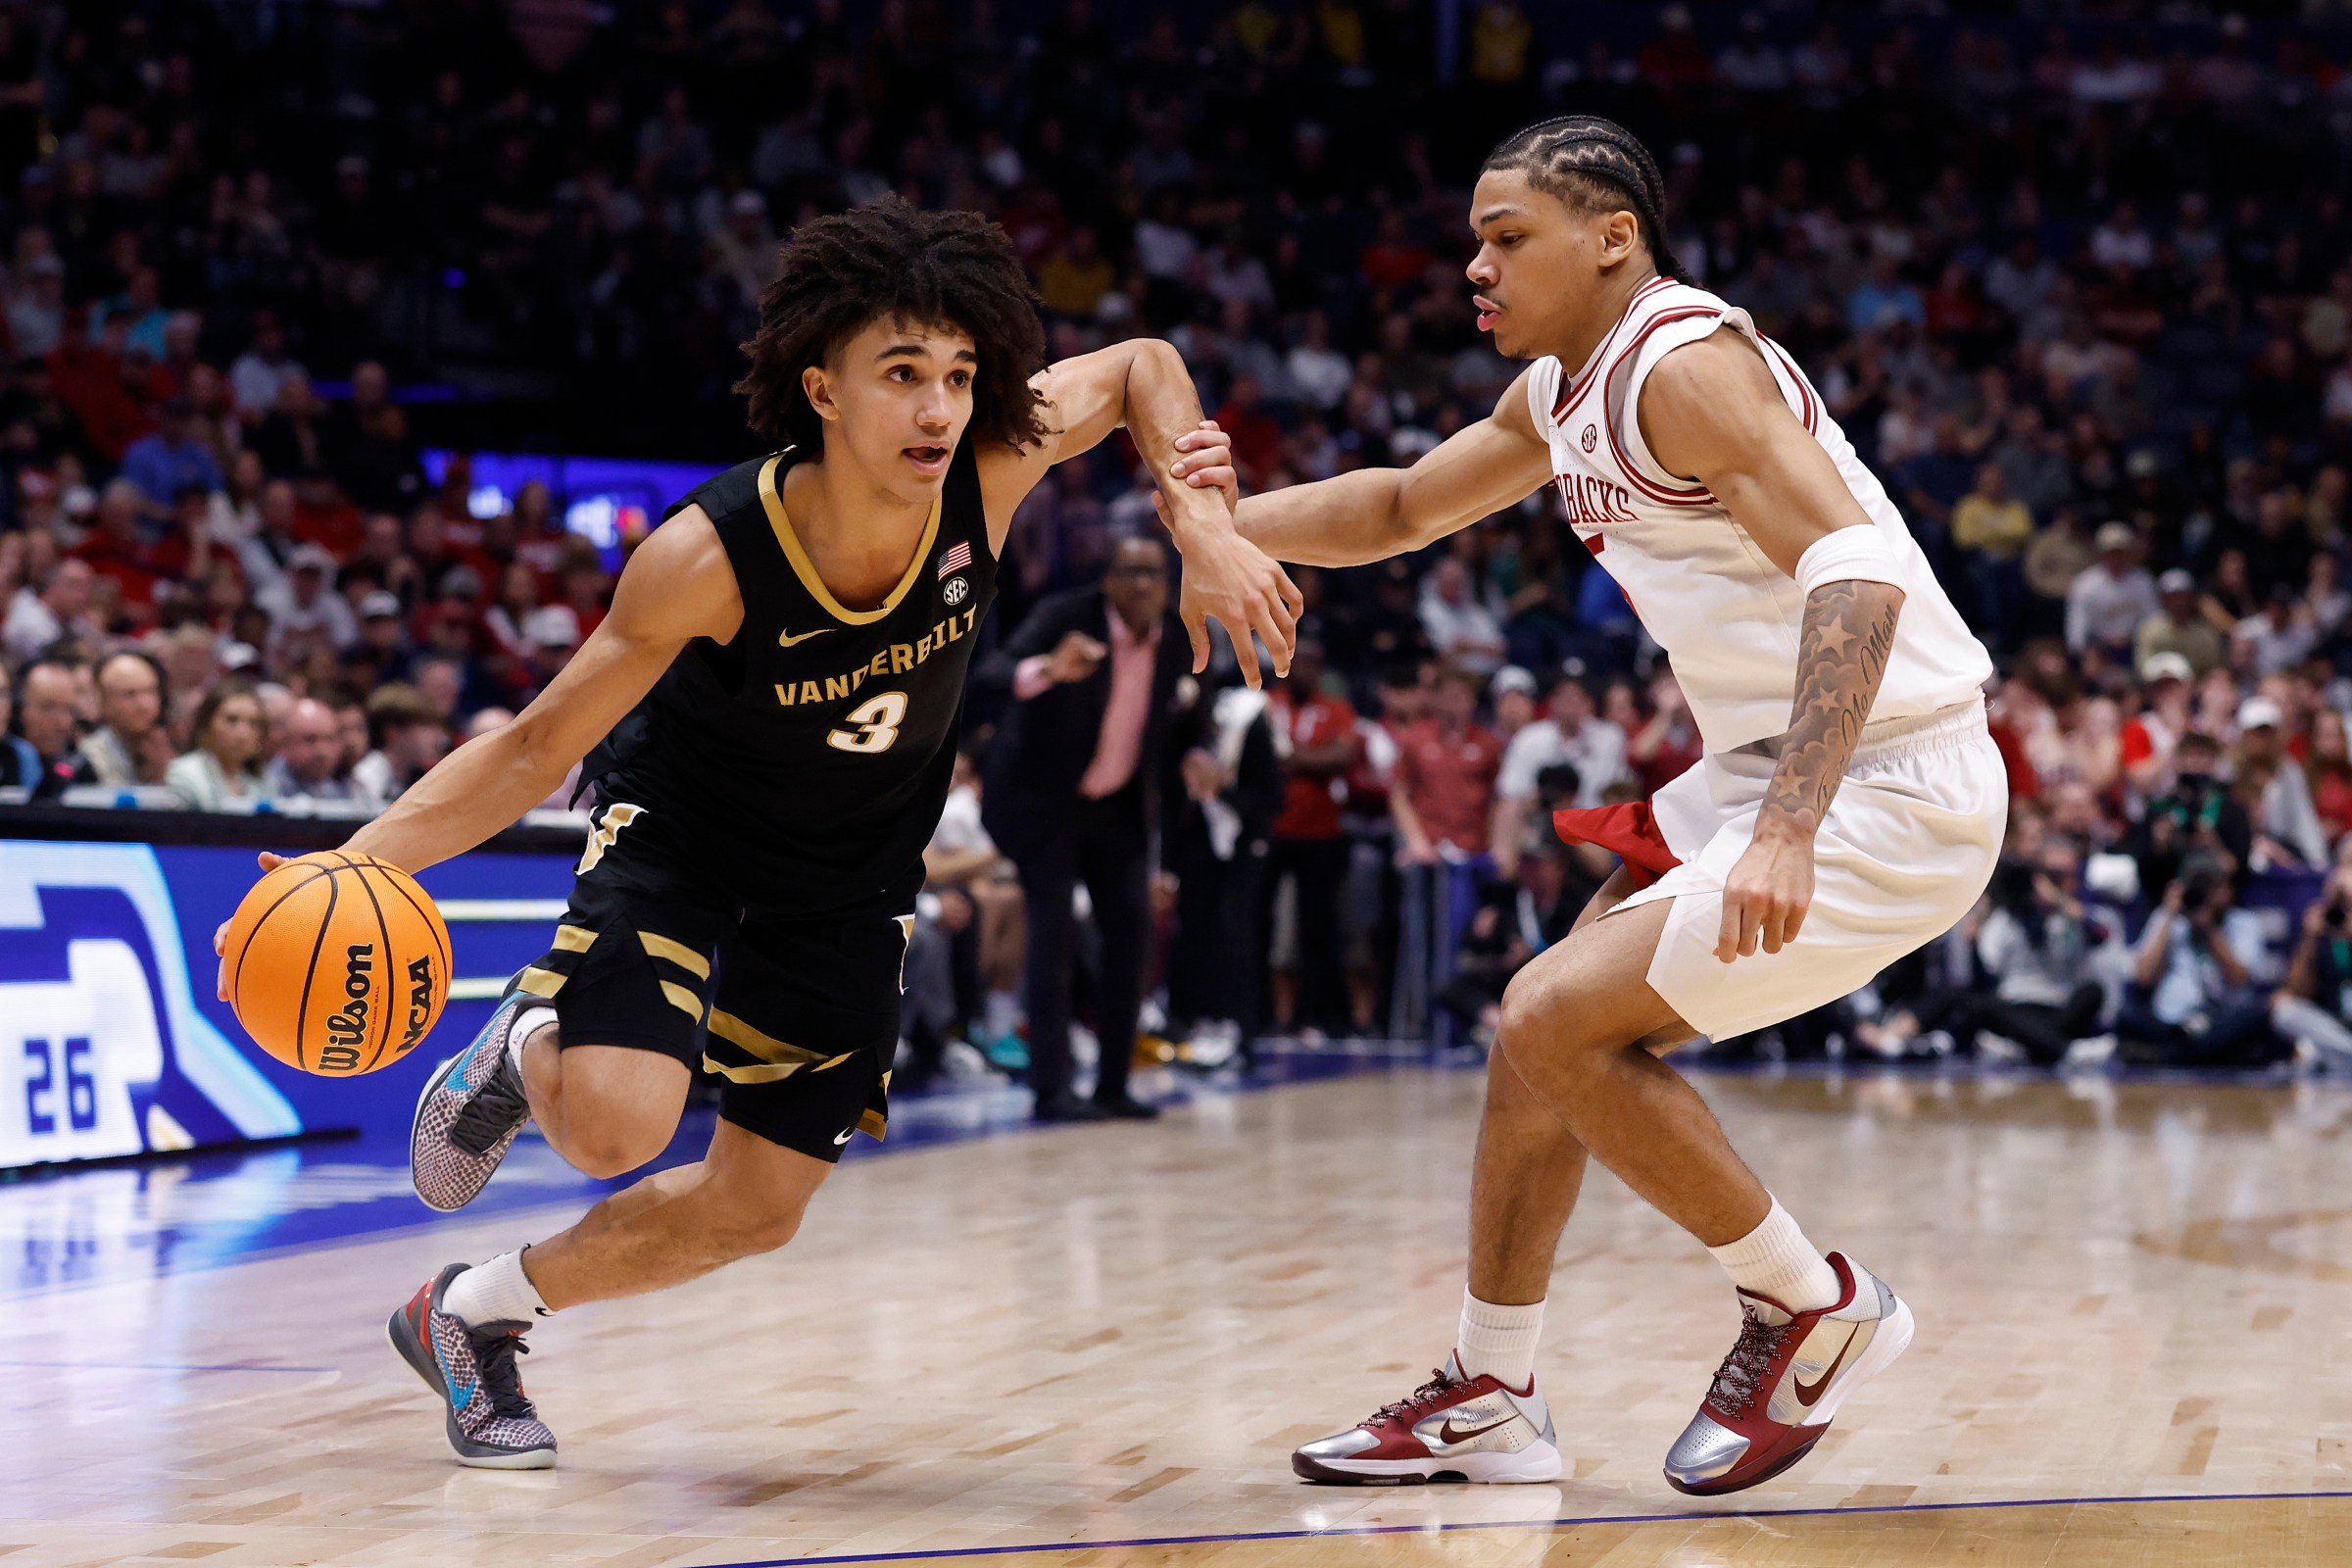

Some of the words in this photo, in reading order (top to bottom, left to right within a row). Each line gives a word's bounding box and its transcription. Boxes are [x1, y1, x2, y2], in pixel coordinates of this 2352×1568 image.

[945, 579, 966, 604] SEC
[774, 603, 977, 707] VANDERBILT
[1842, 693, 1869, 747] No
[1860, 604, 1896, 686] Man
[826, 691, 908, 754] 3
[318, 942, 373, 1072] Wilson
[395, 955, 433, 1054] NCAA
[24, 1037, 96, 1133] 26
